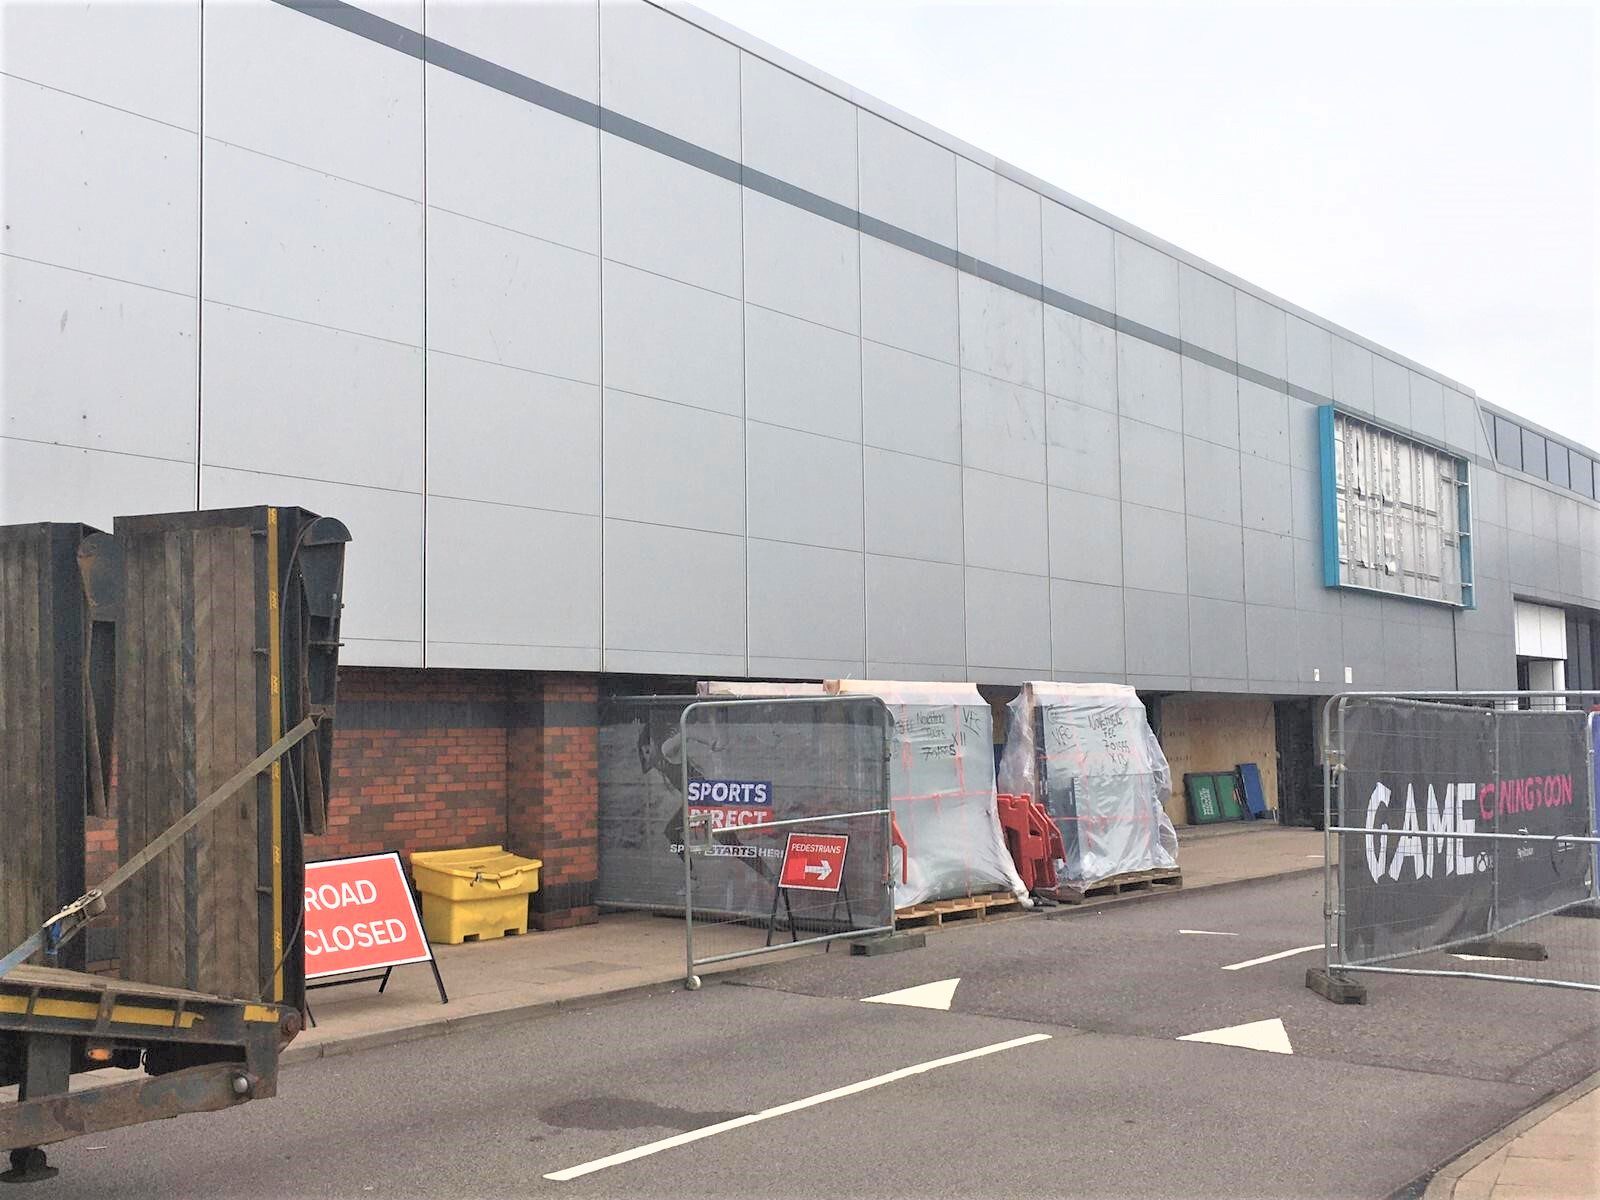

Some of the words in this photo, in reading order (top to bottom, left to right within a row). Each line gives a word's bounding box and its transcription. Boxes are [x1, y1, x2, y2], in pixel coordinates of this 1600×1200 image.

[688, 782, 767, 803] SPORTS
[791, 843, 842, 854] PEDESTRIANS
[1365, 781, 1475, 884] GAME
[304, 879, 377, 913] ROAD
[304, 918, 407, 956] CLOSED
